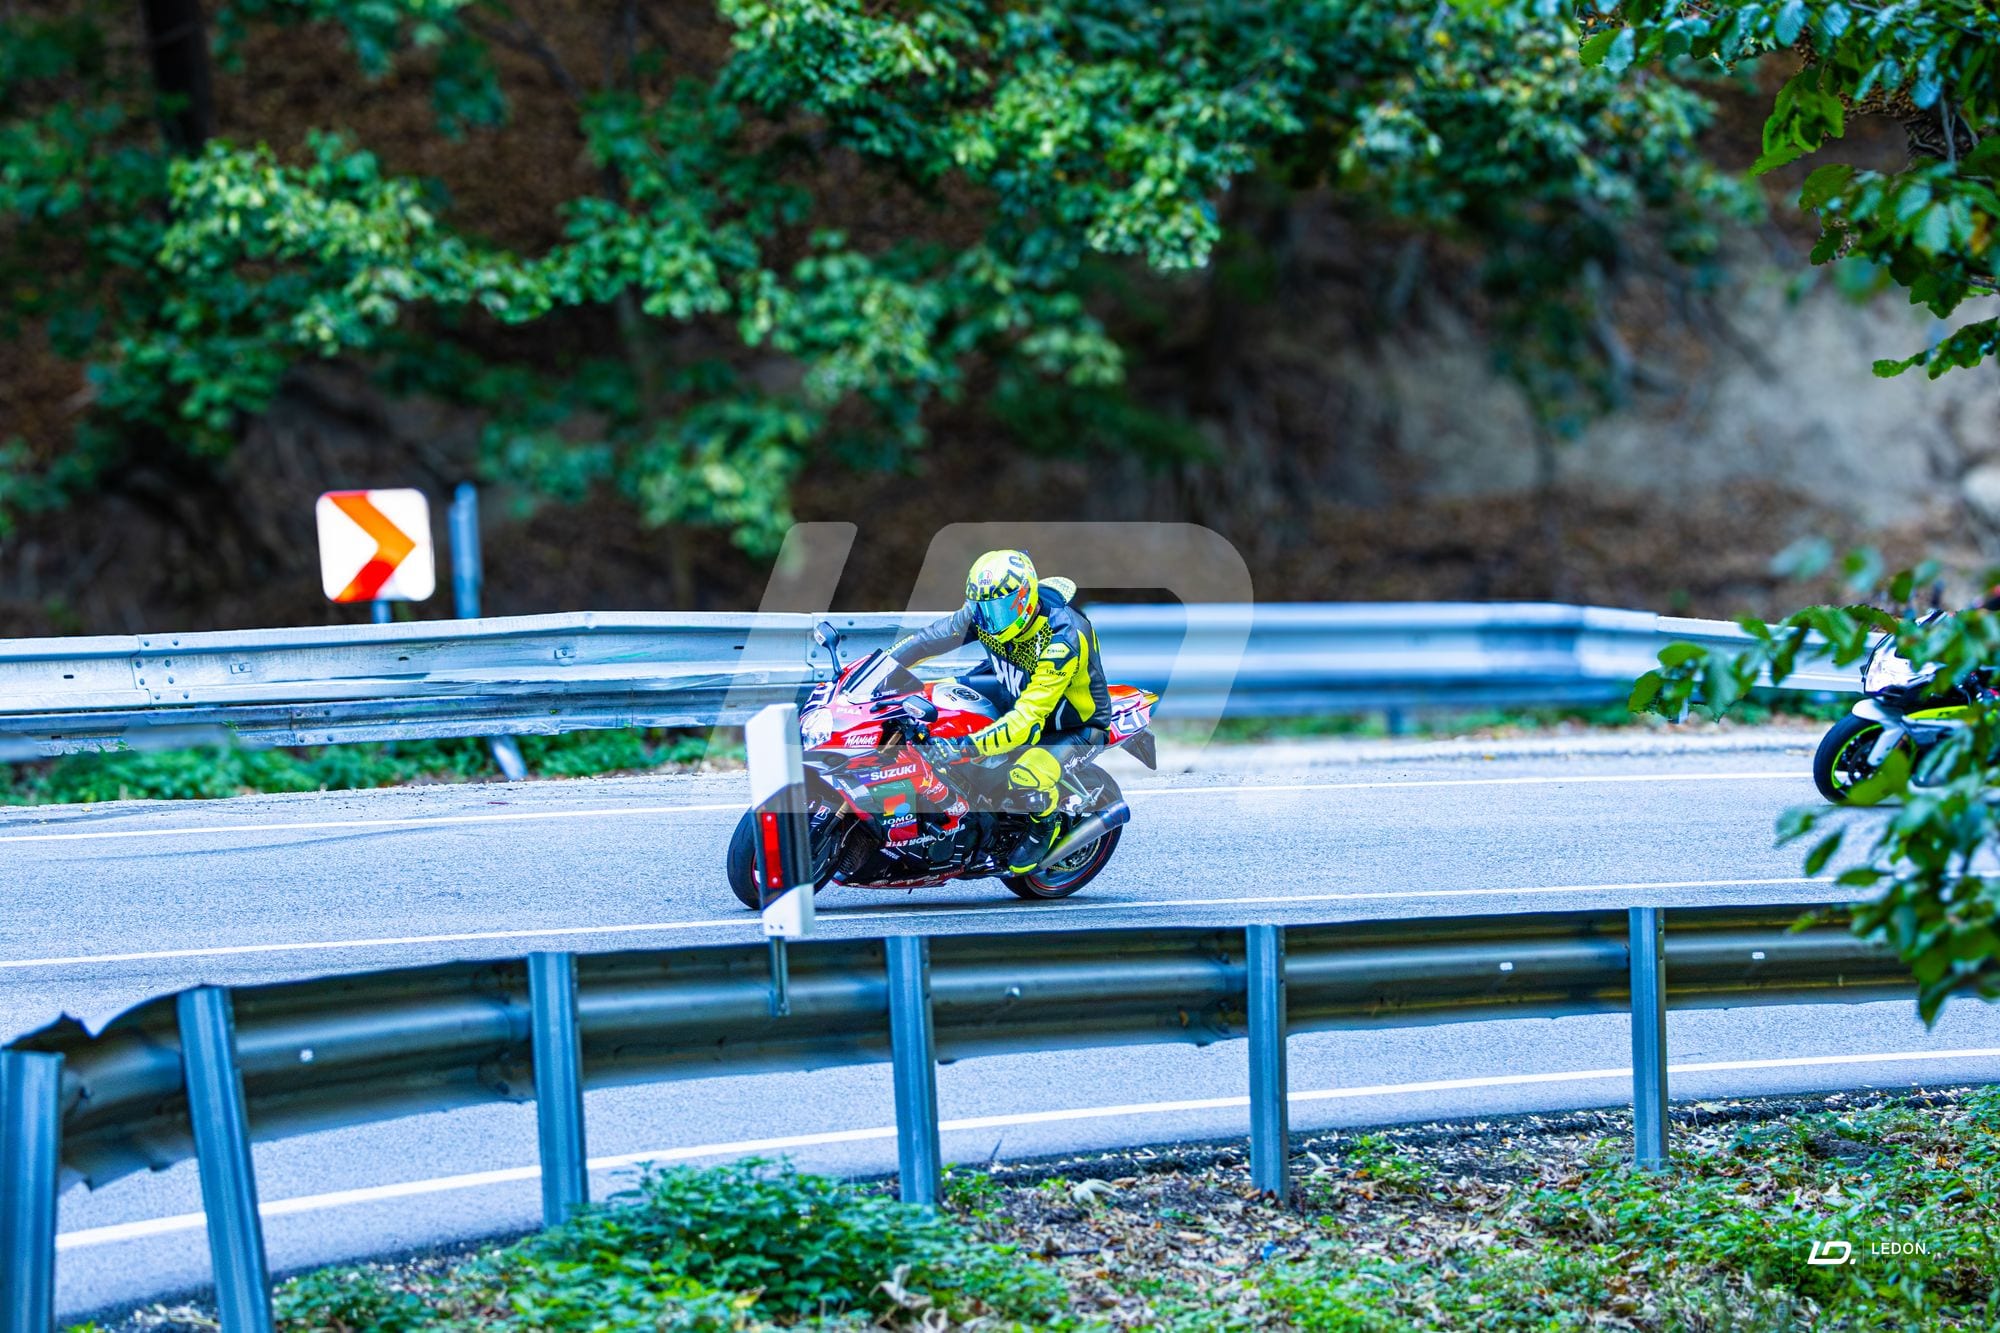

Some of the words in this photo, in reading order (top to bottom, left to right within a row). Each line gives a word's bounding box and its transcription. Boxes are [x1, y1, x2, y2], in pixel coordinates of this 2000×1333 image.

[844, 734, 878, 748] MANIAC
[975, 722, 1012, 752] 777
[870, 764, 917, 781] SUZUKI
[881, 813, 914, 826] JOMO
